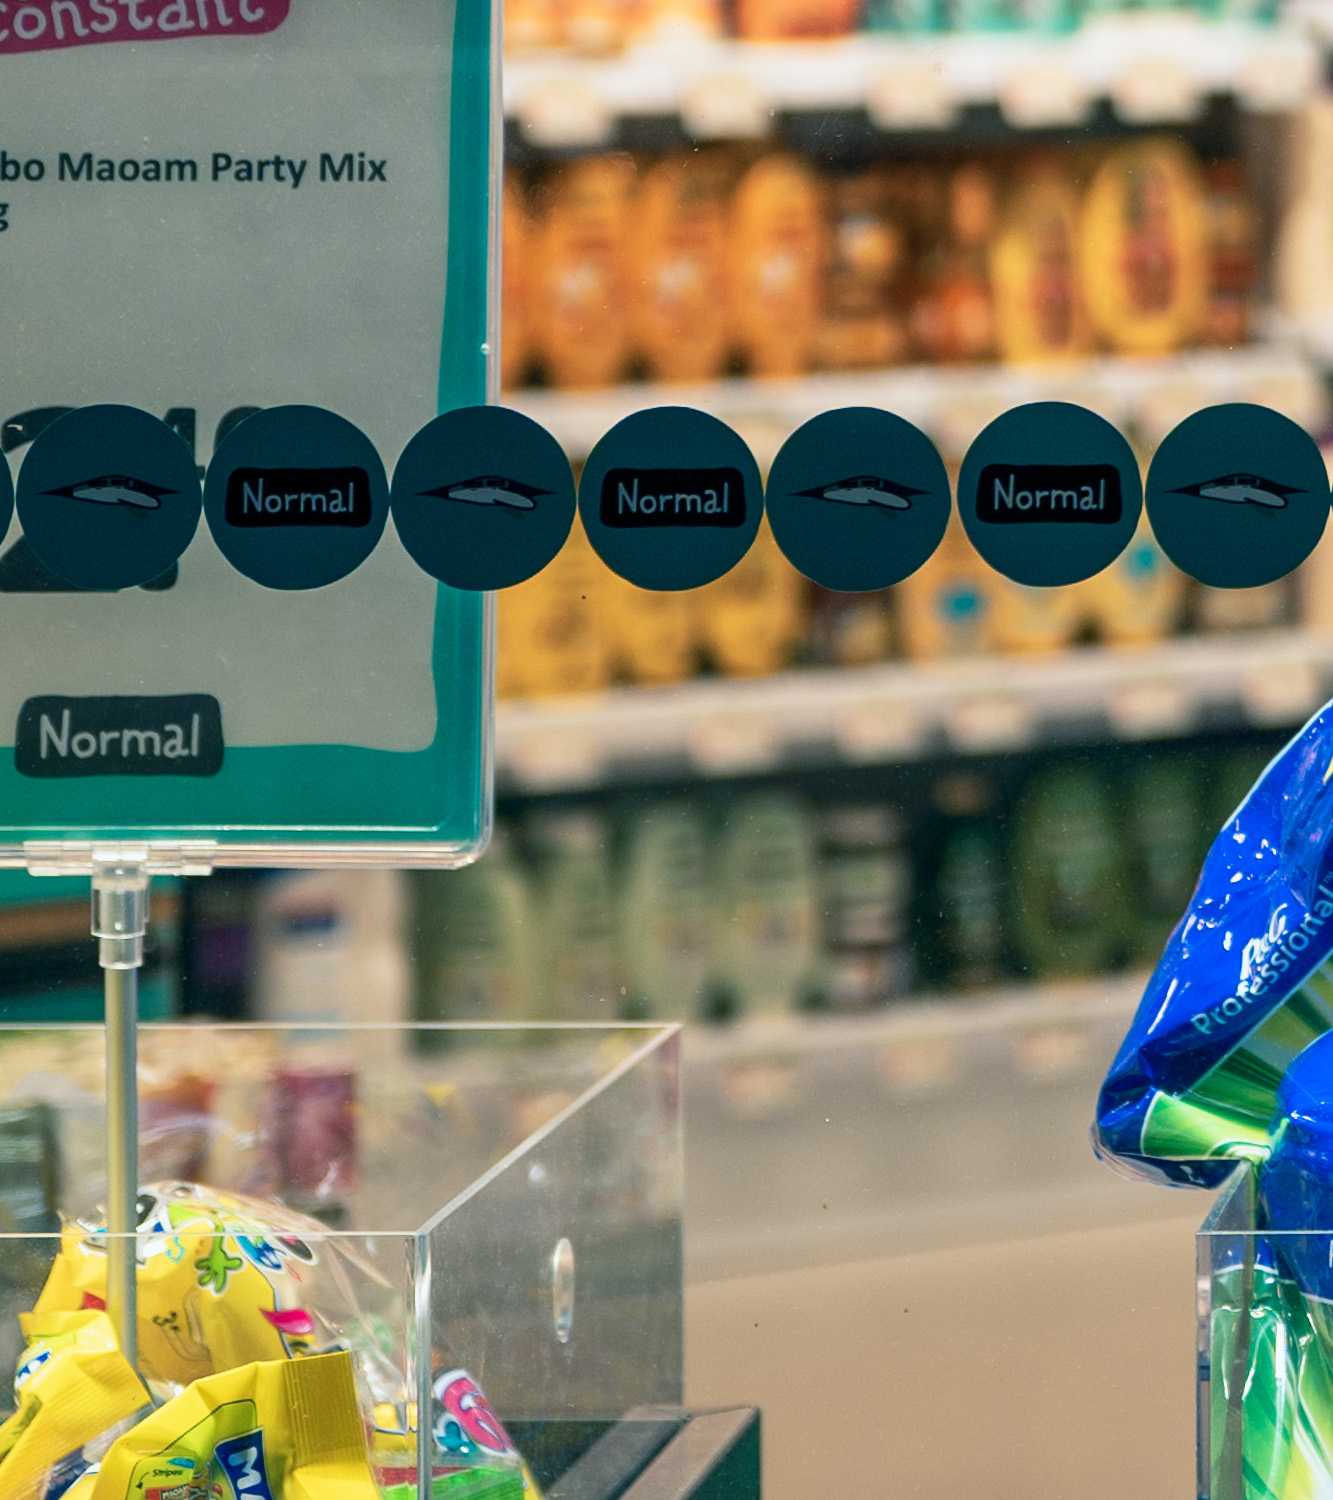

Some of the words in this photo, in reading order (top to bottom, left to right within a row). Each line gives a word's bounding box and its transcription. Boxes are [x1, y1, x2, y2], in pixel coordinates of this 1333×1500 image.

[58, 152, 198, 182] Maoam
[211, 152, 306, 189] Party
[319, 151, 388, 182] Mix
[243, 478, 354, 514] Normal
[618, 478, 729, 515] Normal
[994, 474, 1105, 511] Normal
[40, 708, 200, 759] Normal
